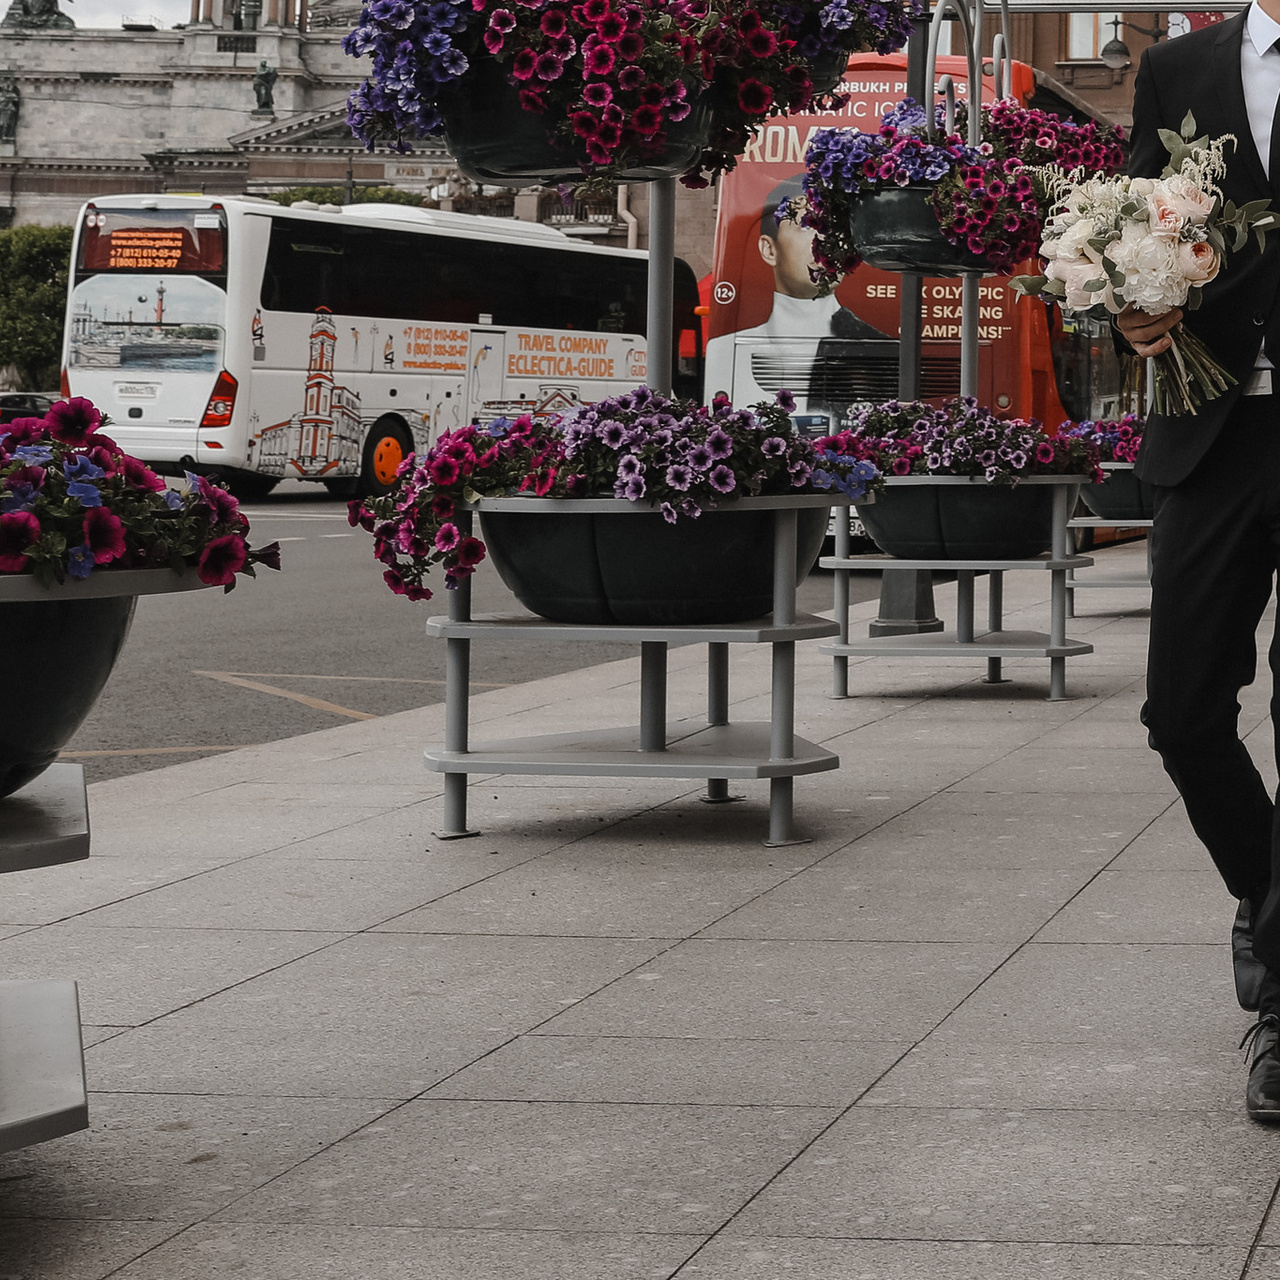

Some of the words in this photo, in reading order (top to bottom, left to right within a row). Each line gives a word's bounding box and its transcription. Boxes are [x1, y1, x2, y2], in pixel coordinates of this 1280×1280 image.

[832, 81, 893, 94] ERBUKH
[717, 287, 734, 298] 12+
[866, 284, 897, 298] SEE
[932, 286, 1004, 300] OLYPIC
[932, 305, 1003, 319] SKANG
[518, 334, 556, 352] TRAVEL
[559, 336, 609, 355] COMPANY
[507, 354, 614, 377] ECLECTICA-GUIDE
